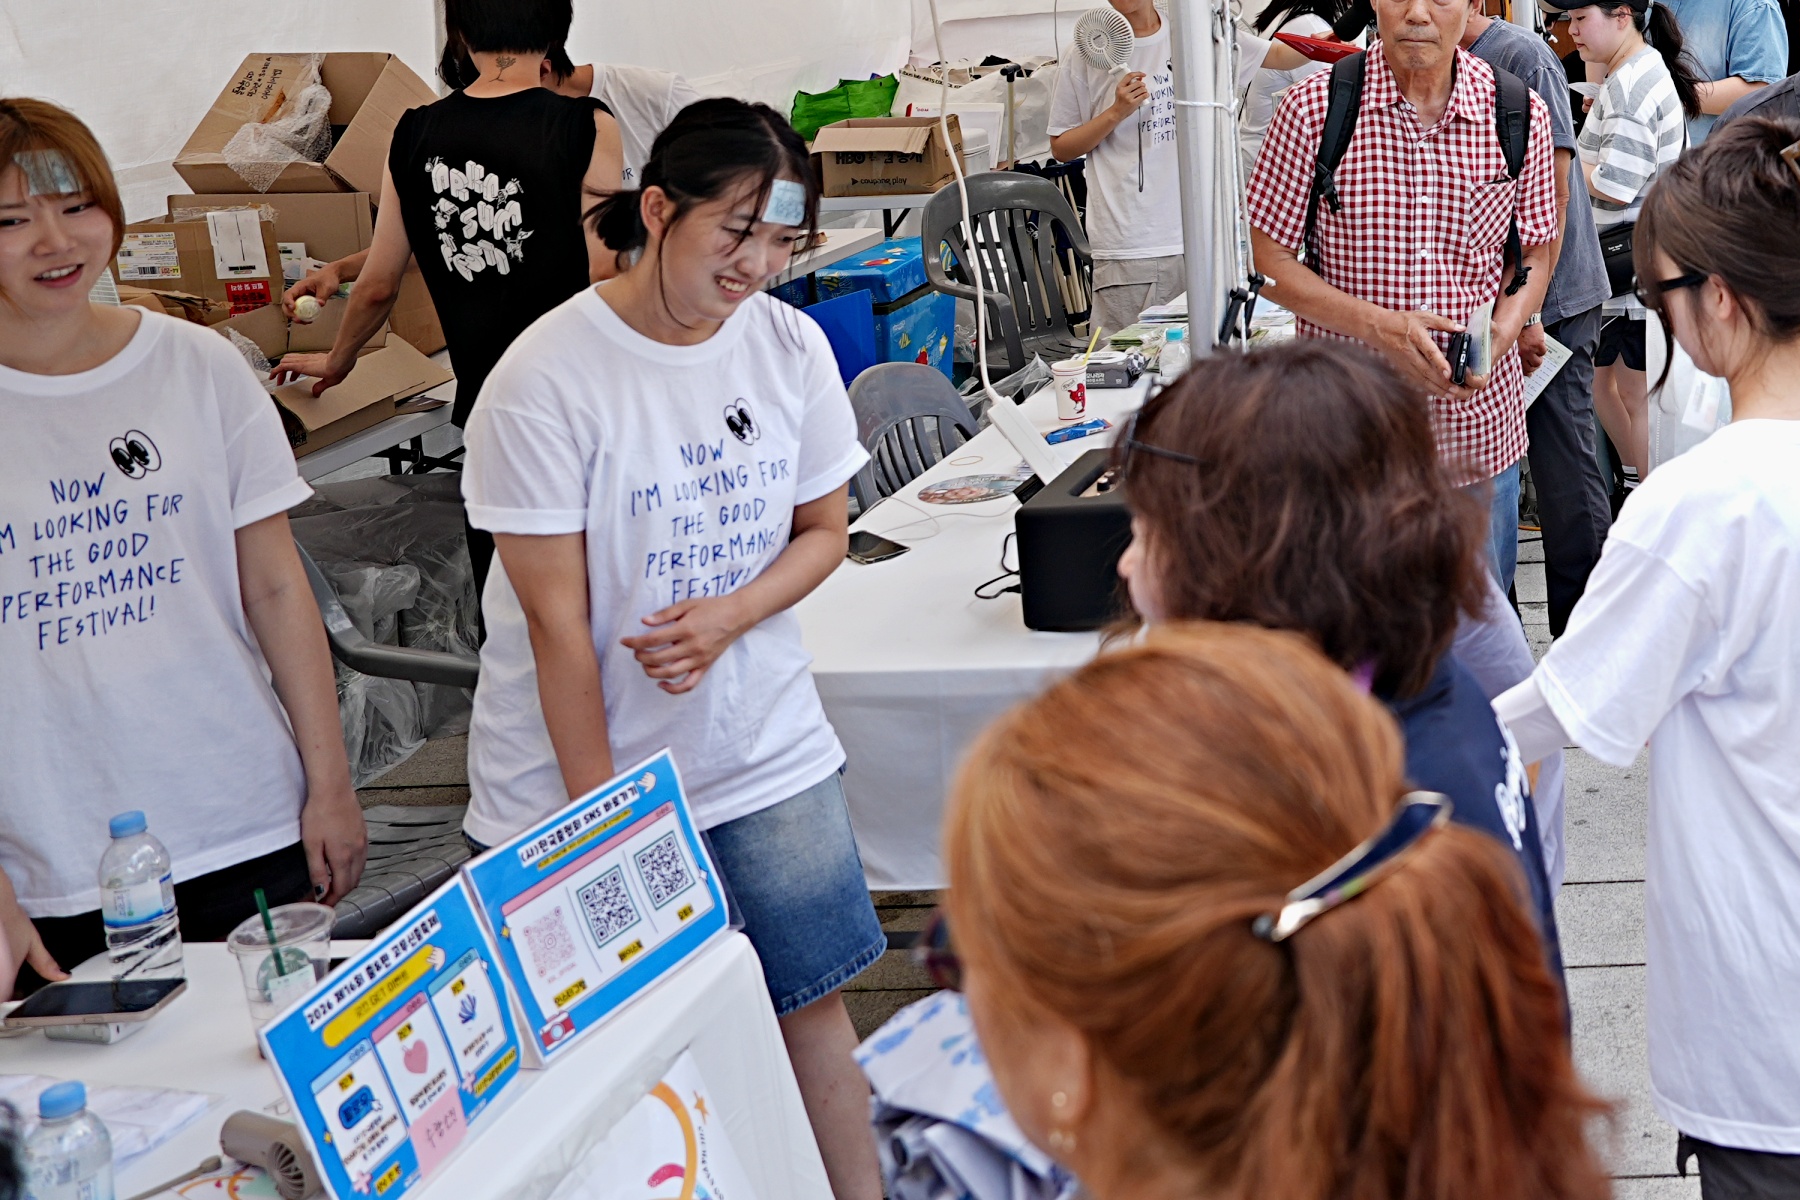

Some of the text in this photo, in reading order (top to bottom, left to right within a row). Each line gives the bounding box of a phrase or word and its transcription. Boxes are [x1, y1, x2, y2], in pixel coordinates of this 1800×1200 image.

[1150, 85, 1175, 101] LOOKIN
[1153, 73, 1169, 85] NOW
[1141, 115, 1176, 133] PERFOR
[1150, 103, 1162, 115] THE
[1154, 129, 1177, 145] FESTI
[836, 151, 866, 165] HBO
[431, 160, 499, 202] ARKO
[860, 176, 908, 186] coupang play
[460, 200, 522, 240] SUM
[680, 438, 724, 468] NOW
[49, 472, 106, 505] NOW
[630, 458, 790, 517] I'M LOOKING FOR
[33, 498, 128, 542] LOOKING
[146, 492, 184, 522] FOR
[671, 497, 767, 538] THE GOOD
[29, 532, 149, 578] THE GOOD
[1, 557, 185, 624] PERFORMANCE
[672, 566, 751, 605] FESTIV
[37, 594, 156, 651] FESTIVAL!
[583, 809, 602, 825] SNS
[604, 786, 638, 813] 바로가기
[306, 1001, 334, 1026] 2026
[334, 973, 365, 1004] 제16회
